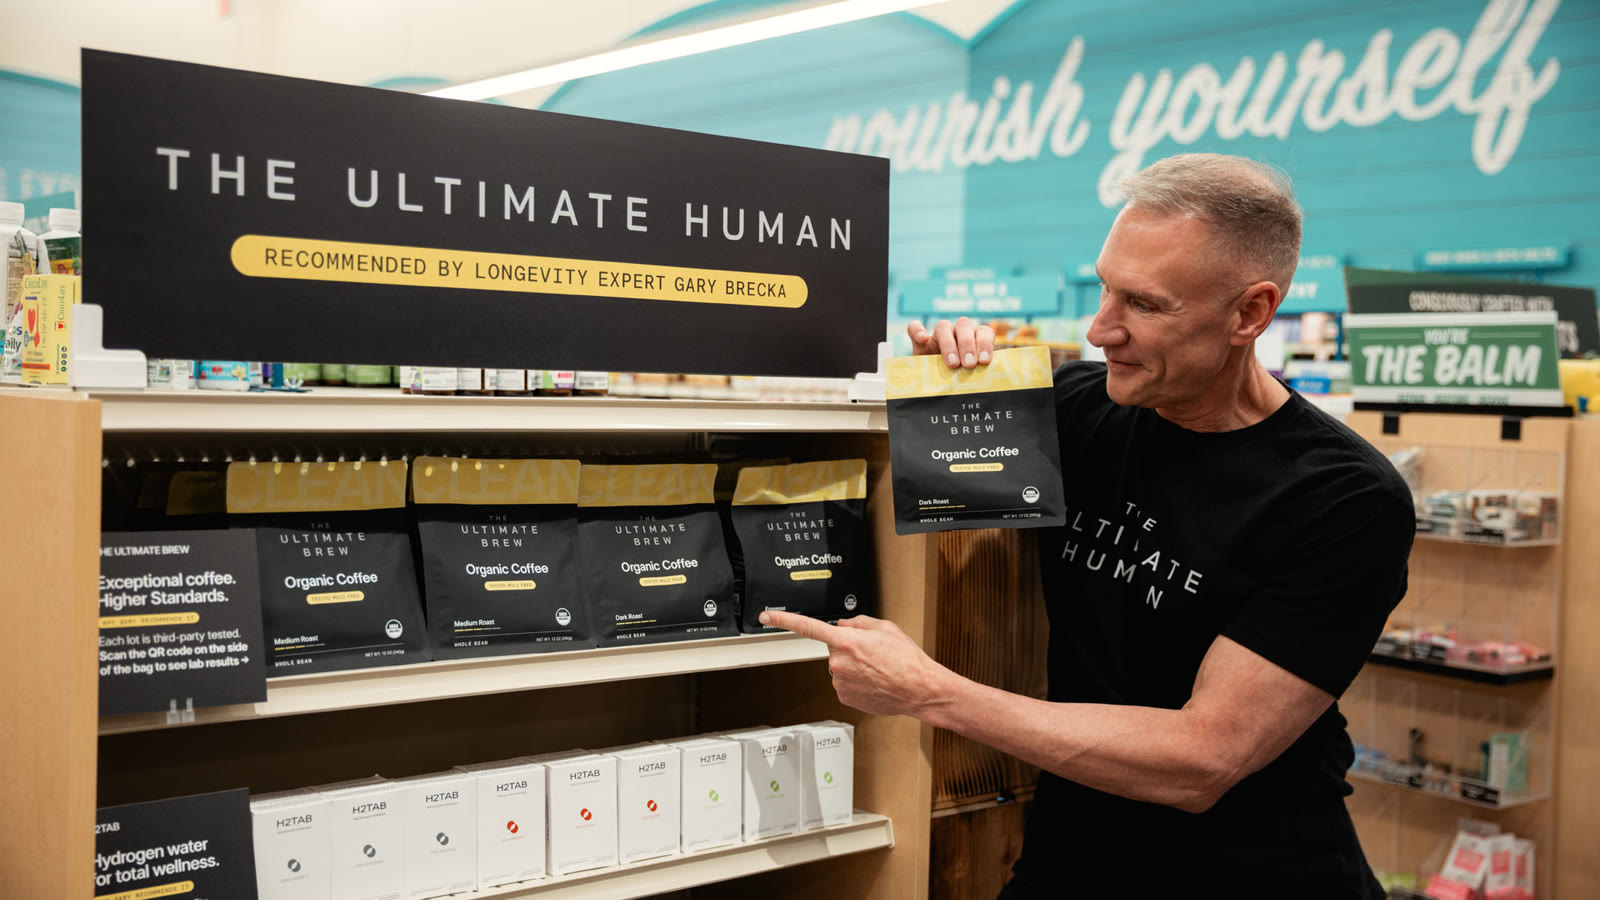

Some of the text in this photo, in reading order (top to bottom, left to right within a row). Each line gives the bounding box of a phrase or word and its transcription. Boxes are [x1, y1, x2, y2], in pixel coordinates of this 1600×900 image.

[825, 0, 1561, 209] nourish yourself
[156, 147, 851, 250] THE ULTIMATE HUMAN
[265, 248, 787, 298] RECOMMENDED BY LONGEVITY EXPERT GARY BRECKA
[1423, 327, 1469, 345] YOU'RE
[1361, 345, 1543, 387] THE BALM
[930, 410, 1013, 424] ULTIMATE
[950, 424, 995, 435] BREW
[931, 446, 1020, 462] Organic Coffee
[226, 462, 407, 510] CLEAN
[413, 459, 581, 501] CLEAN
[579, 464, 716, 503] CLEAN
[1126, 501, 1157, 532] TE
[461, 525, 538, 534] ULTIMATE
[615, 523, 686, 534] ULTIMATE
[767, 519, 834, 531] ULTIMATE
[280, 531, 366, 544] ULTIMATE
[481, 538, 523, 547] BREW
[633, 536, 672, 546] BREW
[784, 531, 820, 542] BREW
[99, 545, 190, 557] HE ULTIMATE BREW
[303, 546, 349, 557] BREW
[1066, 507, 1203, 594] LTIATE
[621, 558, 698, 574] Organic Coffee
[774, 553, 843, 569] Organic Coffee
[465, 562, 549, 578] Organic Coffee
[1062, 540, 1164, 610] HUMN
[98, 571, 237, 592] Exceptional coffee.
[284, 572, 378, 591] Organic Coffee
[98, 588, 229, 612] Higher Standards.
[98, 628, 241, 647] Each lot is third-party tested.
[274, 635, 318, 645] Medium Roast
[99, 641, 248, 662] Scan the QR code on the side
[99, 656, 240, 676] of the bag to see lab results
[274, 659, 295, 667] WHOLE
[762, 744, 787, 755] H2TAB
[816, 737, 841, 747] H2TAB
[700, 752, 727, 763] H2TAB
[569, 769, 601, 781] H2TAB
[638, 761, 666, 773] H2TAB
[496, 780, 528, 792] H2TAB
[425, 791, 459, 803] H2TAB
[352, 801, 387, 814] H2TAB
[94, 821, 121, 834] 2TAB
[276, 814, 313, 828] H2TAB
[94, 839, 208, 871] Hydrogen water
[115, 865, 150, 884] total
[152, 856, 220, 877] wellness.
[135, 886, 178, 899] RECOMMENDS
[181, 883, 190, 891] IT
